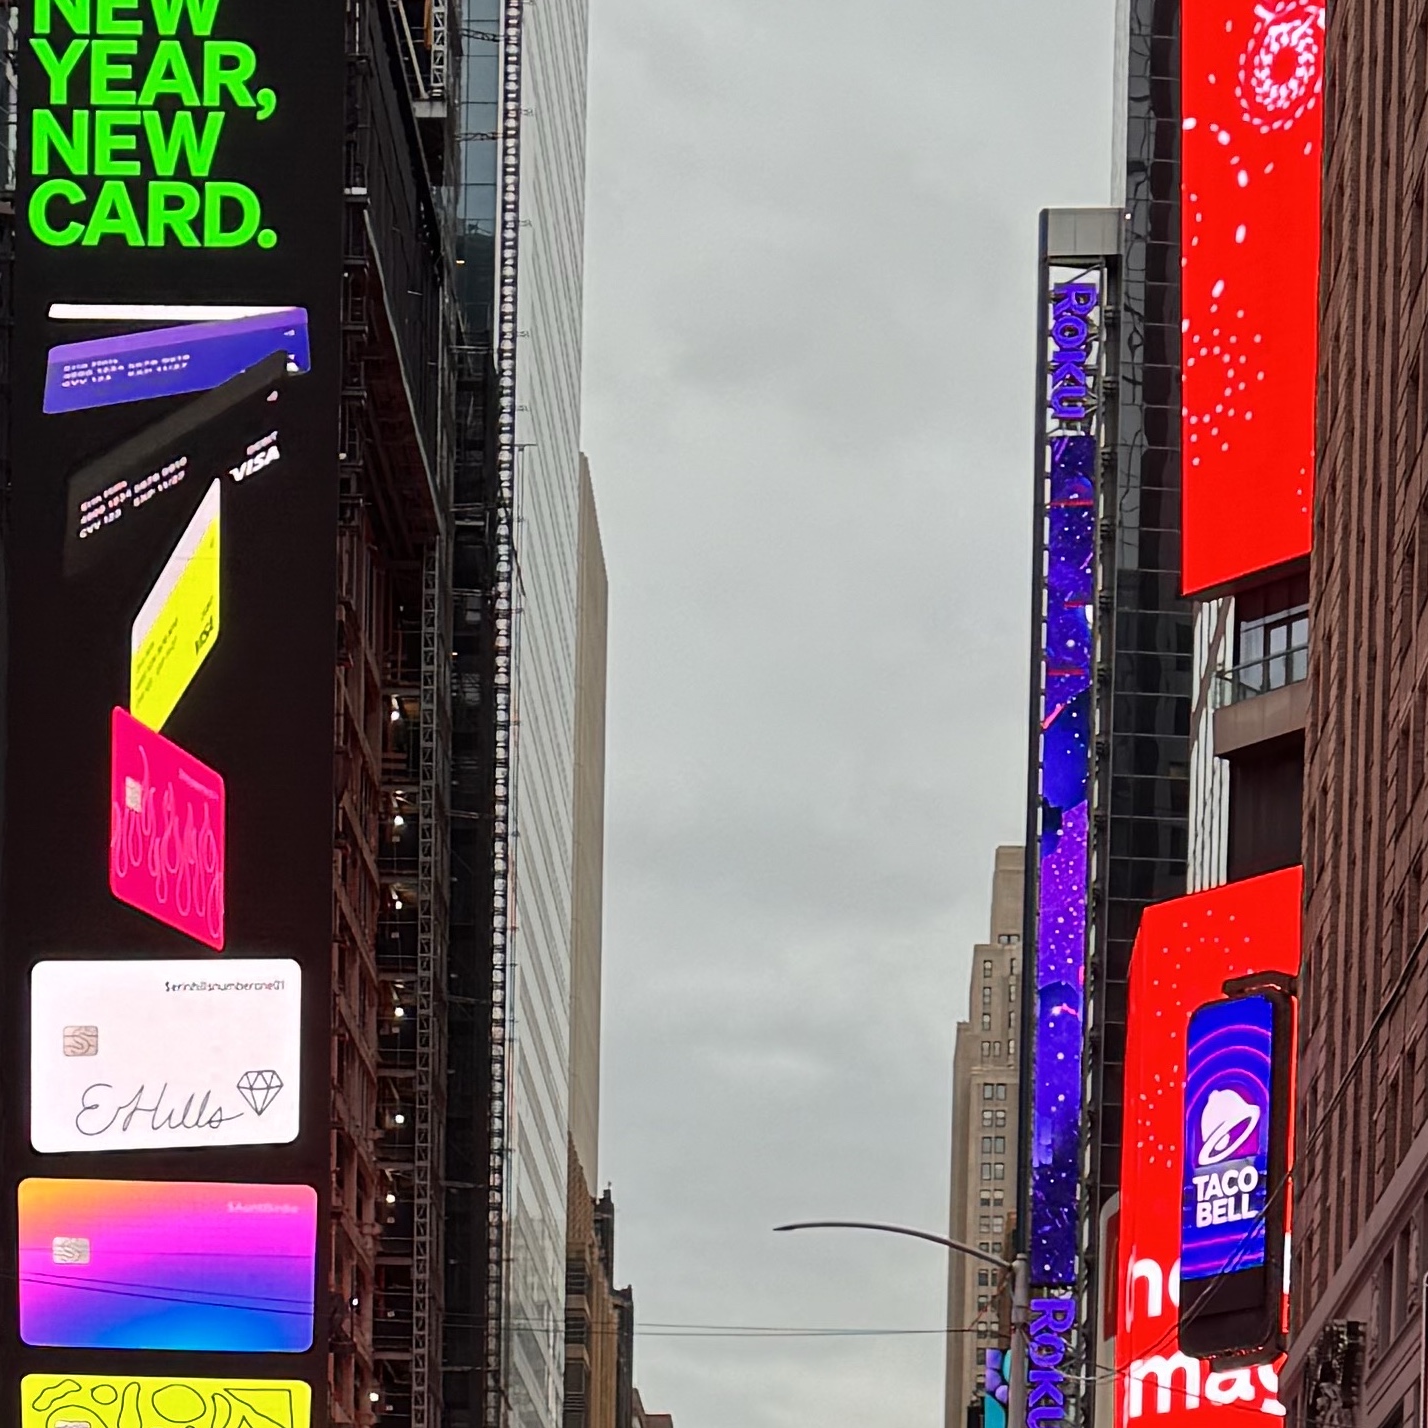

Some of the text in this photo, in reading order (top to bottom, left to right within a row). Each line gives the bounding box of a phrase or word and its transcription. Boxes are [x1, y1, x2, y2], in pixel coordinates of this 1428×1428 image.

[32, 0, 221, 37] NEW
[29, 38, 277, 120] YEAR,
[31, 109, 225, 177] NEW
[28, 178, 278, 248] CARD.
[228, 445, 281, 482] VISA
[1192, 1165, 1258, 1201] TACO
[1195, 1194, 1258, 1229] BELL
